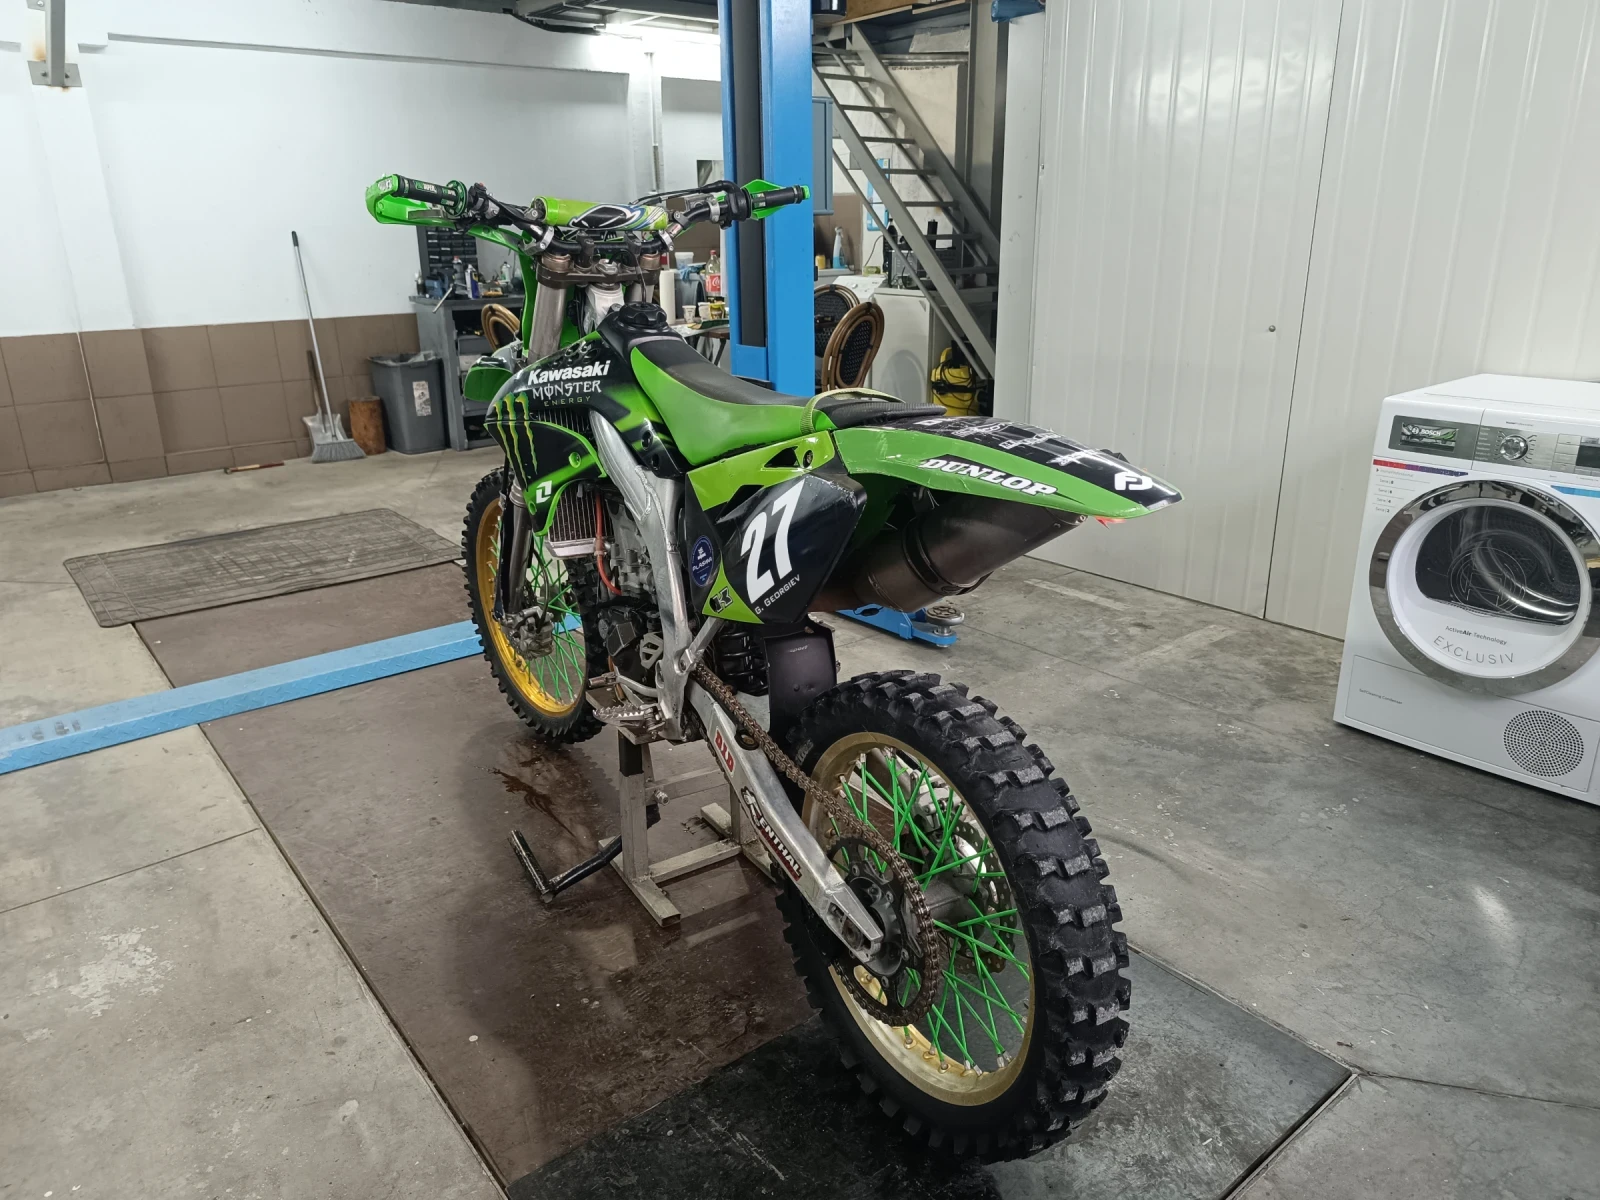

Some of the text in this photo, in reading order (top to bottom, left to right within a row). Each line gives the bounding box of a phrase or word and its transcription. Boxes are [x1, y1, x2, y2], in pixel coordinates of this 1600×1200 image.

[527, 360, 611, 386] Kawasaki
[532, 380, 602, 400] MONSTER
[544, 395, 591, 407] ENERGY
[1420, 428, 1441, 437] BOSCH
[918, 457, 1058, 496] DUNLOP
[740, 478, 805, 604] 27
[764, 574, 801, 607] GEORGIEV
[1433, 635, 1514, 665] EXCLUSIV
[1473, 632, 1508, 646] Technology
